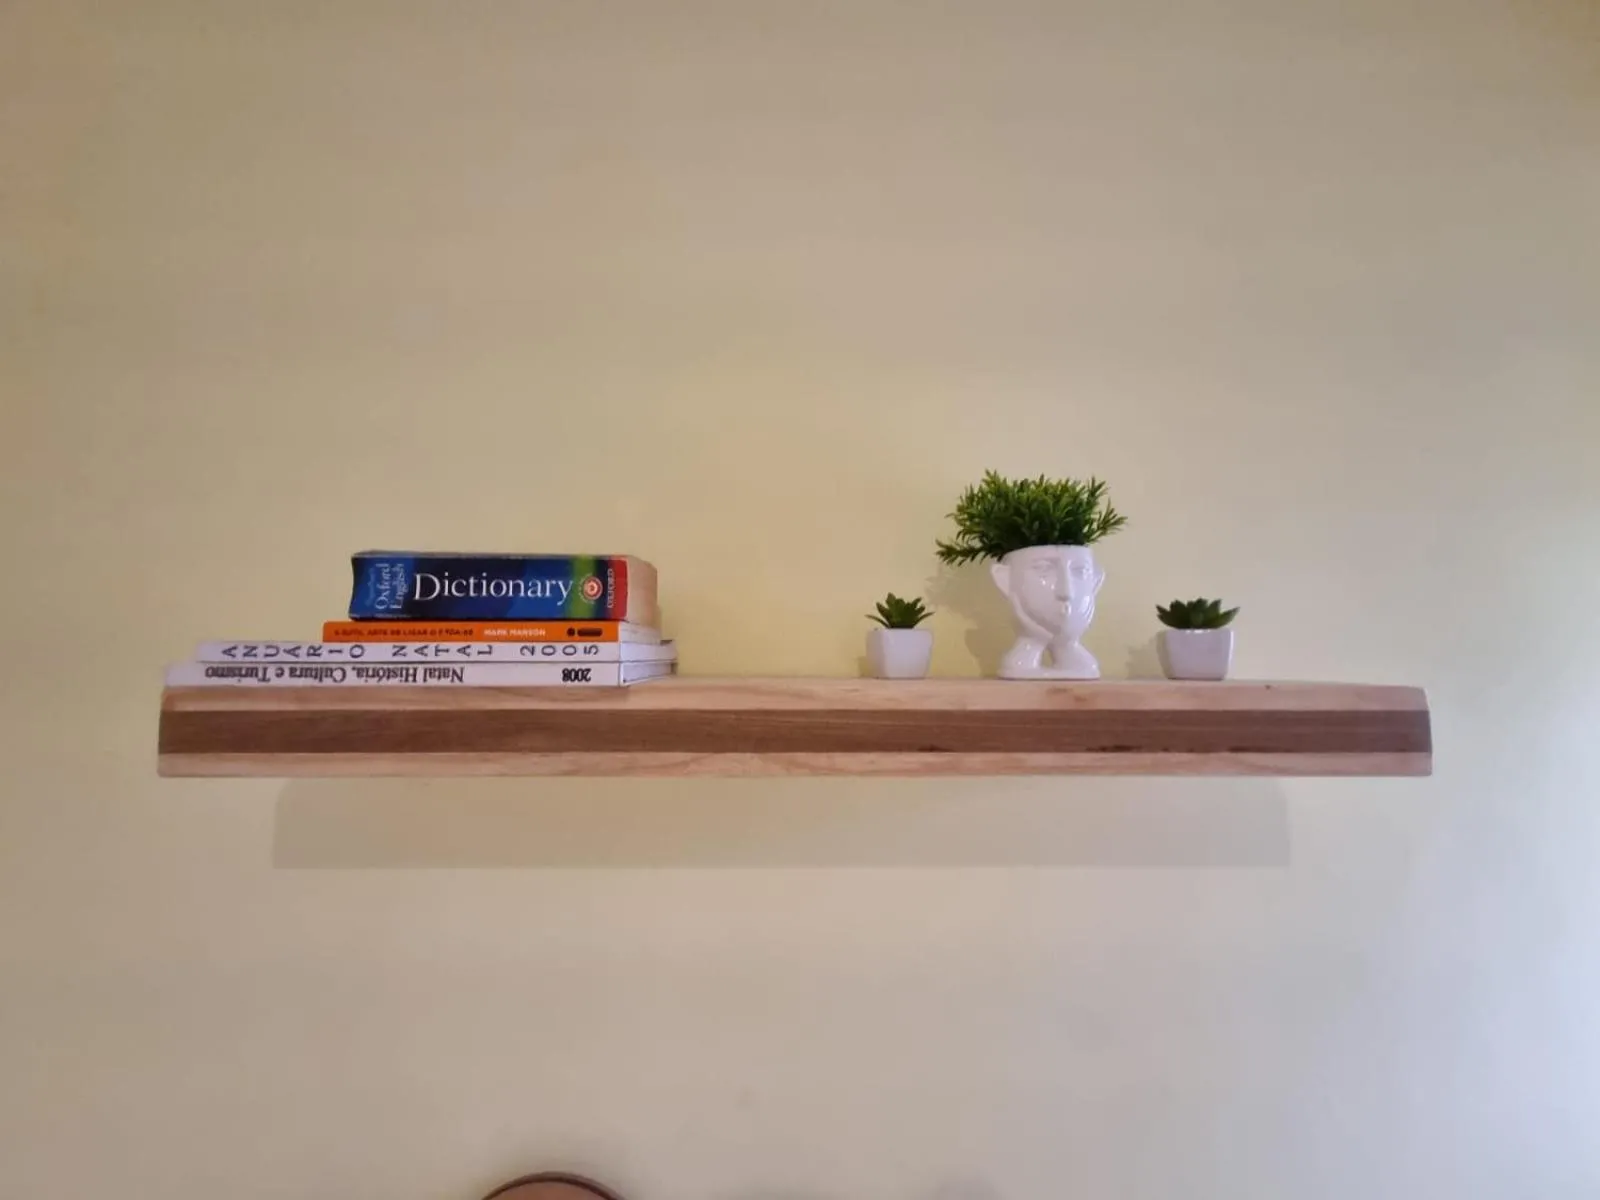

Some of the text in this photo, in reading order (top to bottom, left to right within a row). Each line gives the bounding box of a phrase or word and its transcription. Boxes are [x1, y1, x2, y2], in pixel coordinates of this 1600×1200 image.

[374, 563, 392, 610] Oxford
[413, 571, 574, 606] Dictionary
[221, 644, 599, 659] ANUÁRIO NATAL 2005
[204, 667, 271, 683] Turismo
[274, 668, 285, 679] e
[288, 667, 347, 683] Cultura
[422, 667, 464, 683] Natal
[562, 668, 592, 682] 2008
